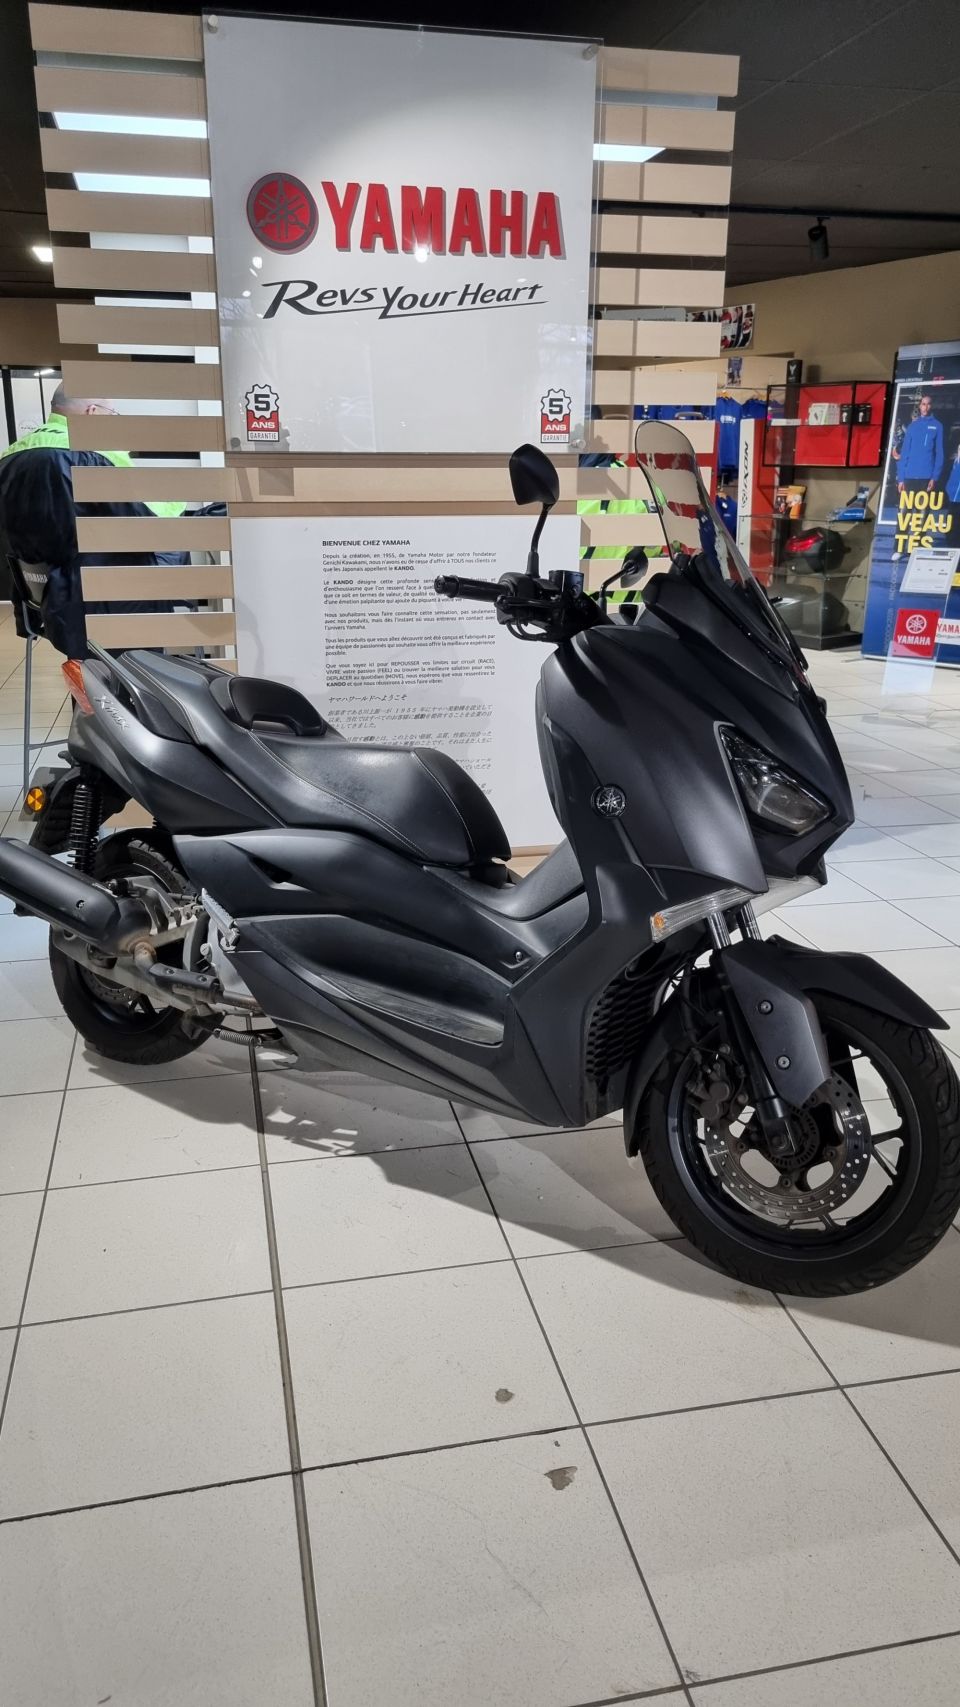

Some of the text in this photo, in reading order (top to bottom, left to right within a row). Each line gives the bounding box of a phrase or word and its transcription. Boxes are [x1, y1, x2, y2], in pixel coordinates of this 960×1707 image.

[321, 181, 564, 258] YAMAHA
[261, 280, 377, 319] Revs
[457, 282, 543, 306] Heart
[254, 394, 270, 411] 5
[549, 398, 563, 414] 5
[900, 490, 944, 510] NOU
[898, 513, 952, 533] VEAU
[898, 634, 930, 646] YAMAHA
